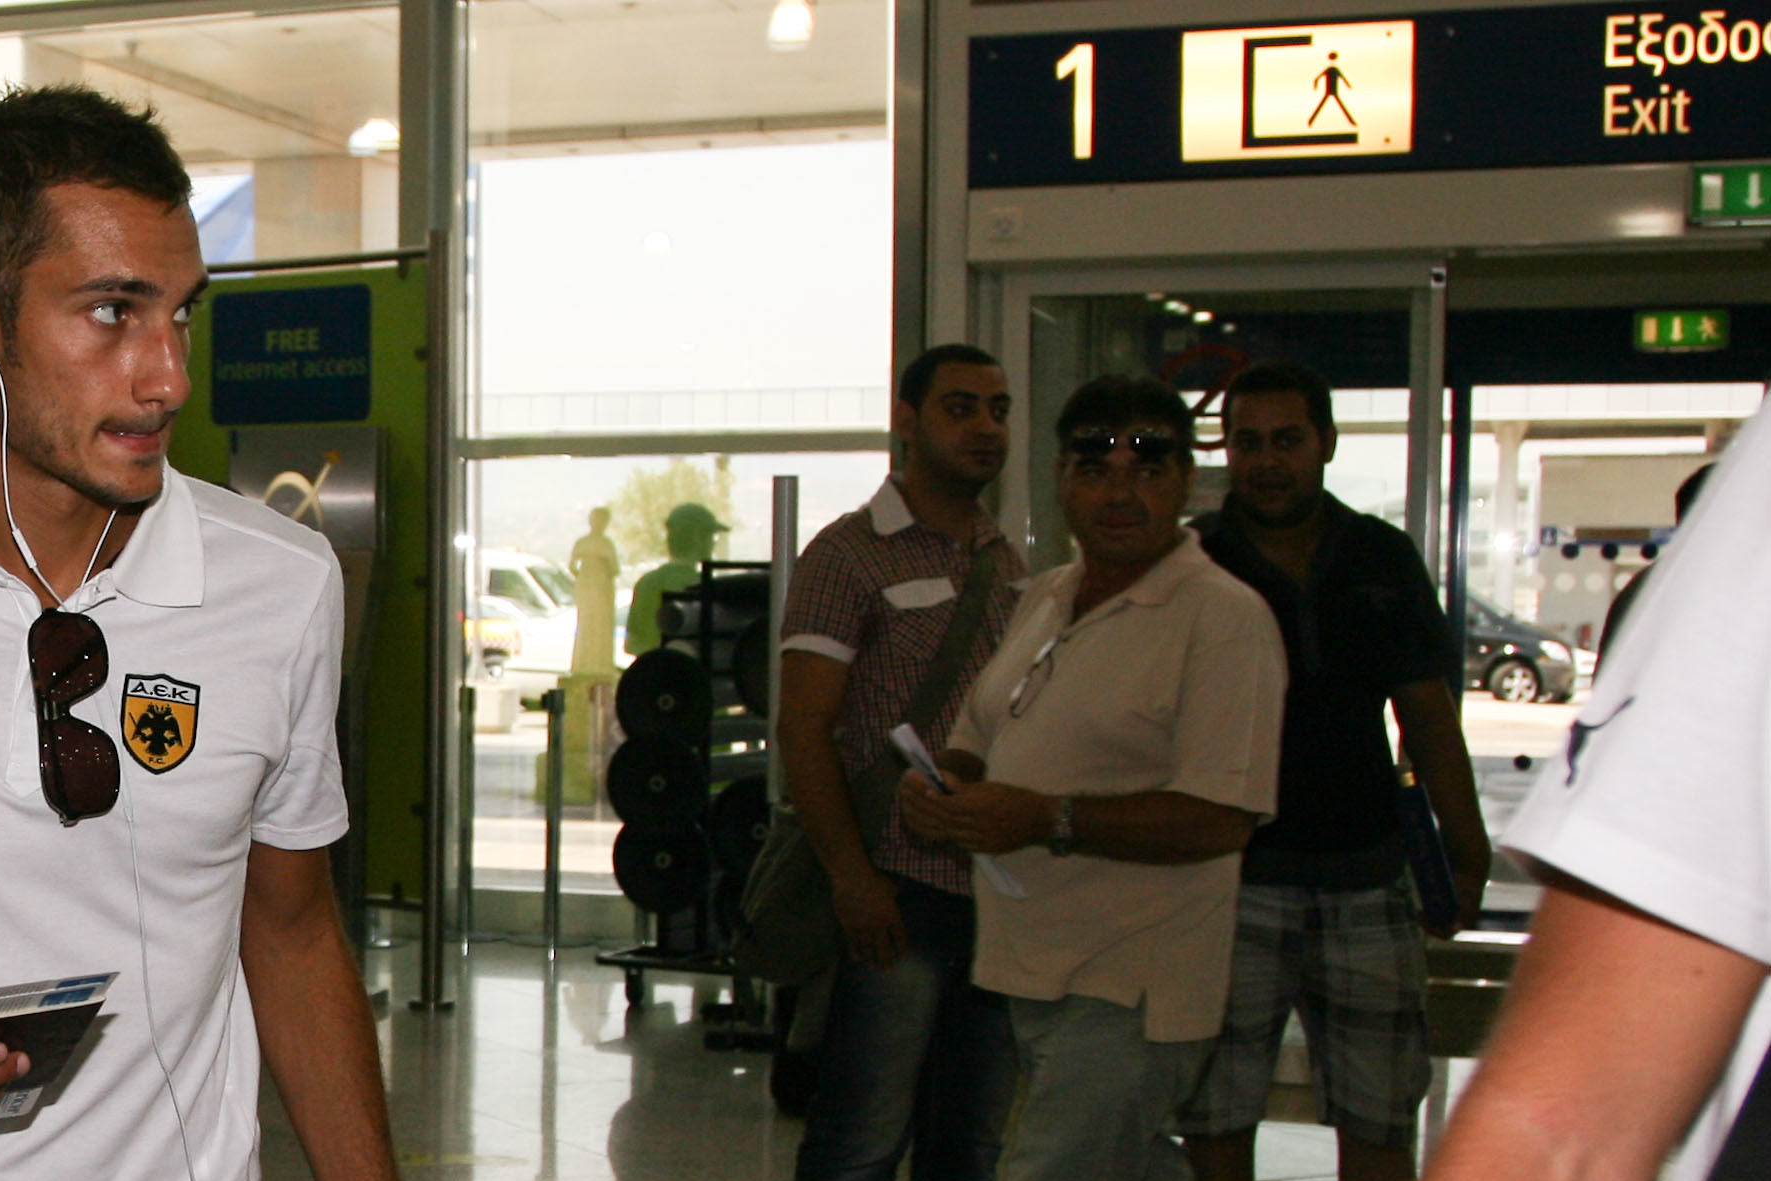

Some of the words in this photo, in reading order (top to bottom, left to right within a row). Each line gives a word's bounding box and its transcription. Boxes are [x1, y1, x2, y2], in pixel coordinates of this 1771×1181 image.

[1055, 42, 1096, 160] 1
[1603, 83, 1692, 137] Exit
[264, 328, 321, 352] FREE
[217, 360, 298, 381] internet
[301, 356, 367, 379] access
